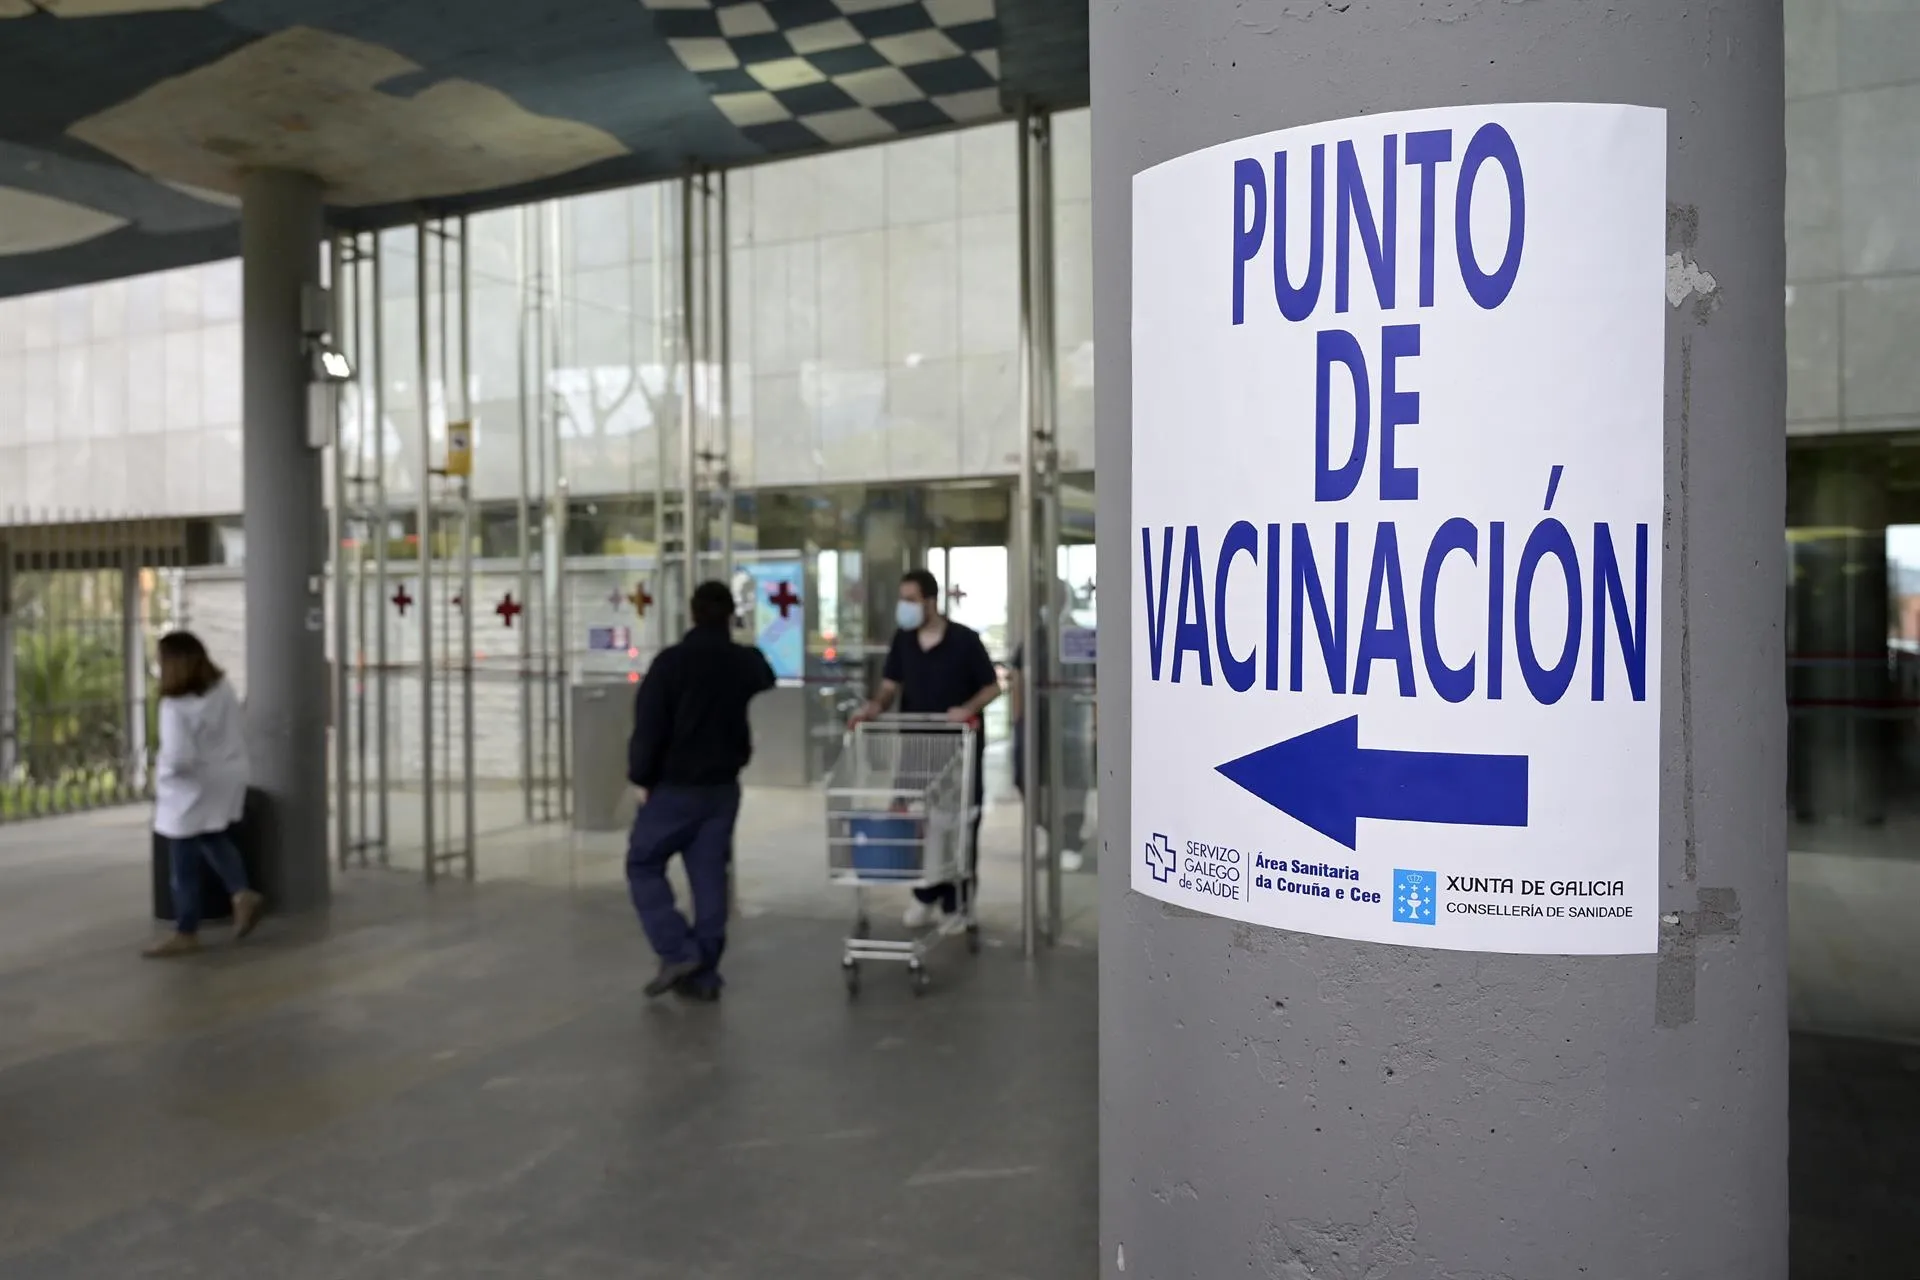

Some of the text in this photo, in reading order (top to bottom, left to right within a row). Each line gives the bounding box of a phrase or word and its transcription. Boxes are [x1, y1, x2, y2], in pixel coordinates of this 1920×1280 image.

[1232, 122, 1526, 326] PUNTO
[1314, 323, 1421, 503] DE
[1141, 464, 1649, 706] VACINACIÓN
[1186, 840, 1241, 864] SERVIZO
[1255, 851, 1360, 881] Área Sanitaria
[1184, 857, 1240, 882] GALEGO
[1178, 872, 1240, 901] de SAÚDE
[1255, 874, 1381, 904] da Coruña e Cee
[1446, 875, 1624, 897] XUNTA DE GALICIA
[1446, 902, 1633, 918] CONSELLERÍA DE SANIDADE
